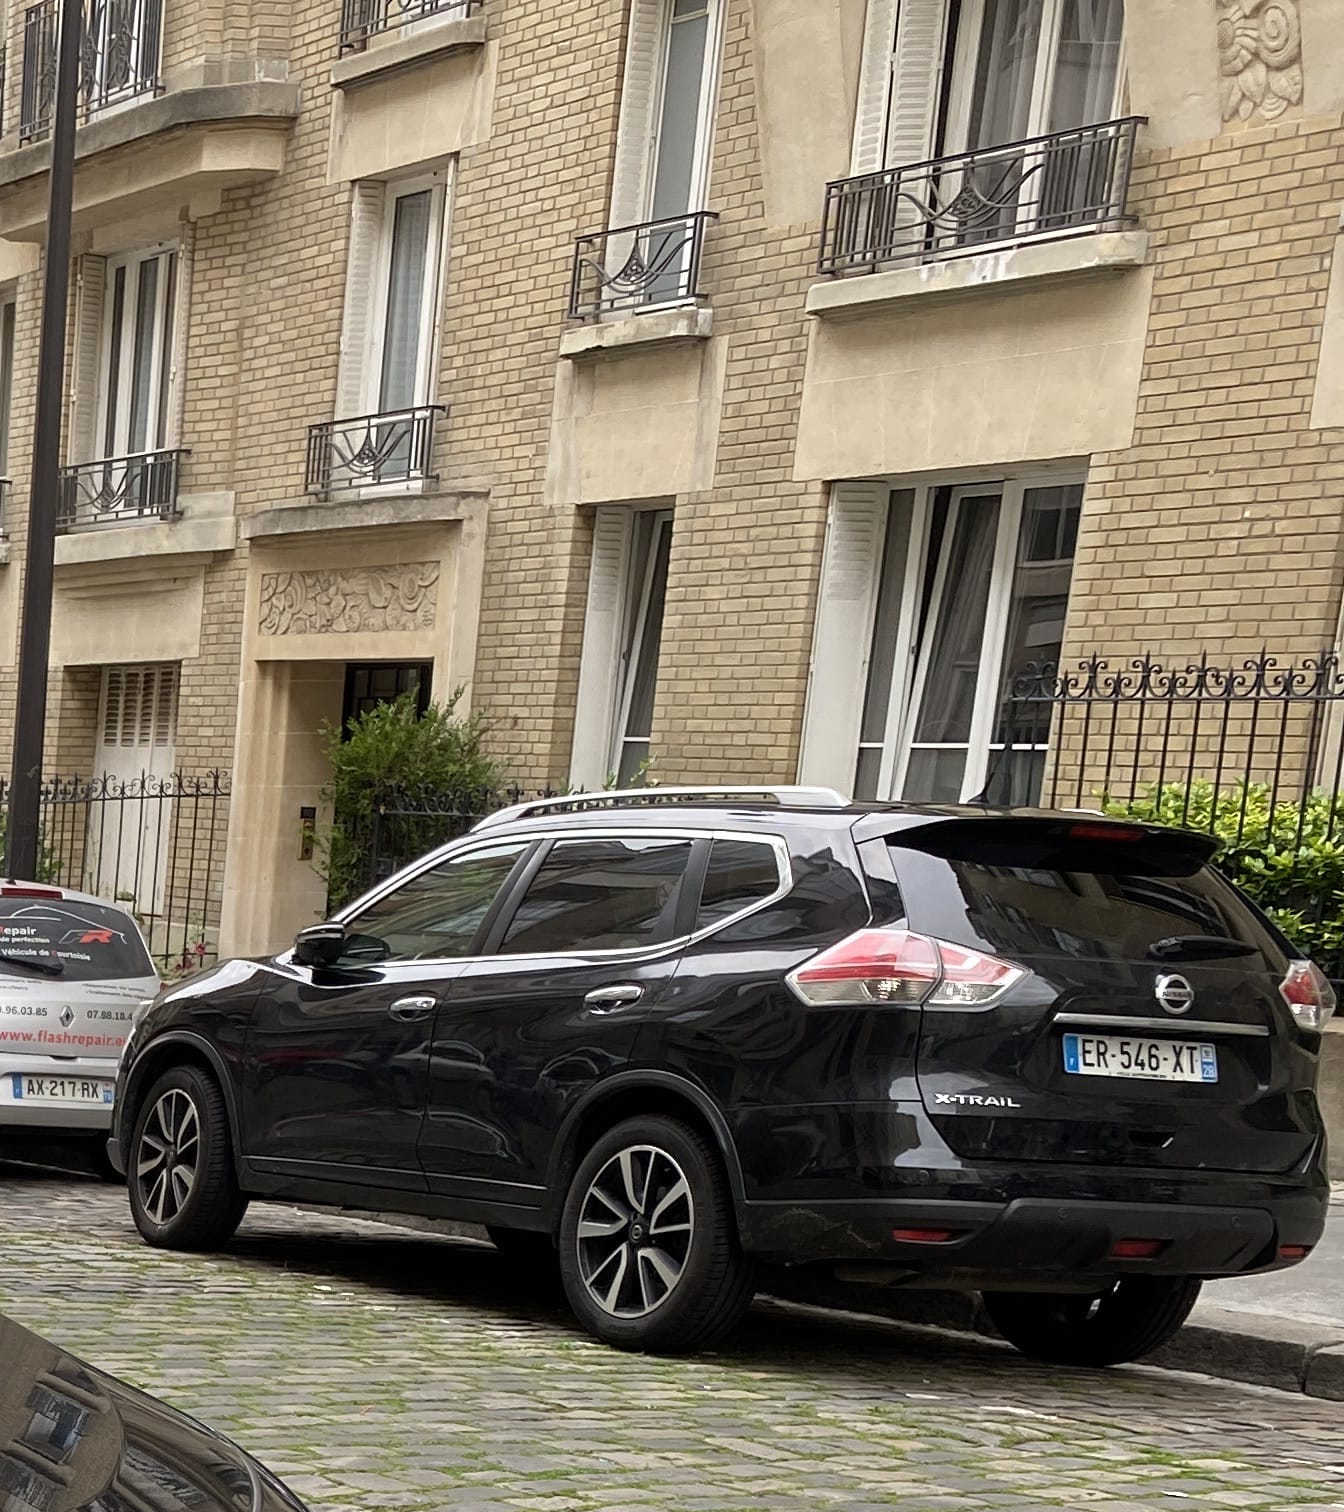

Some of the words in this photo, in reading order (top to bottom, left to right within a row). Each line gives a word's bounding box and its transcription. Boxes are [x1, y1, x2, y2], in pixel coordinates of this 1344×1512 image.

[39, 949, 50, 957] de
[86, 1009, 133, 1021] 07.88.18.4
[1081, 1038, 1198, 1075] ER-546-XT
[934, 1093, 1022, 1108] X-TRAIL
